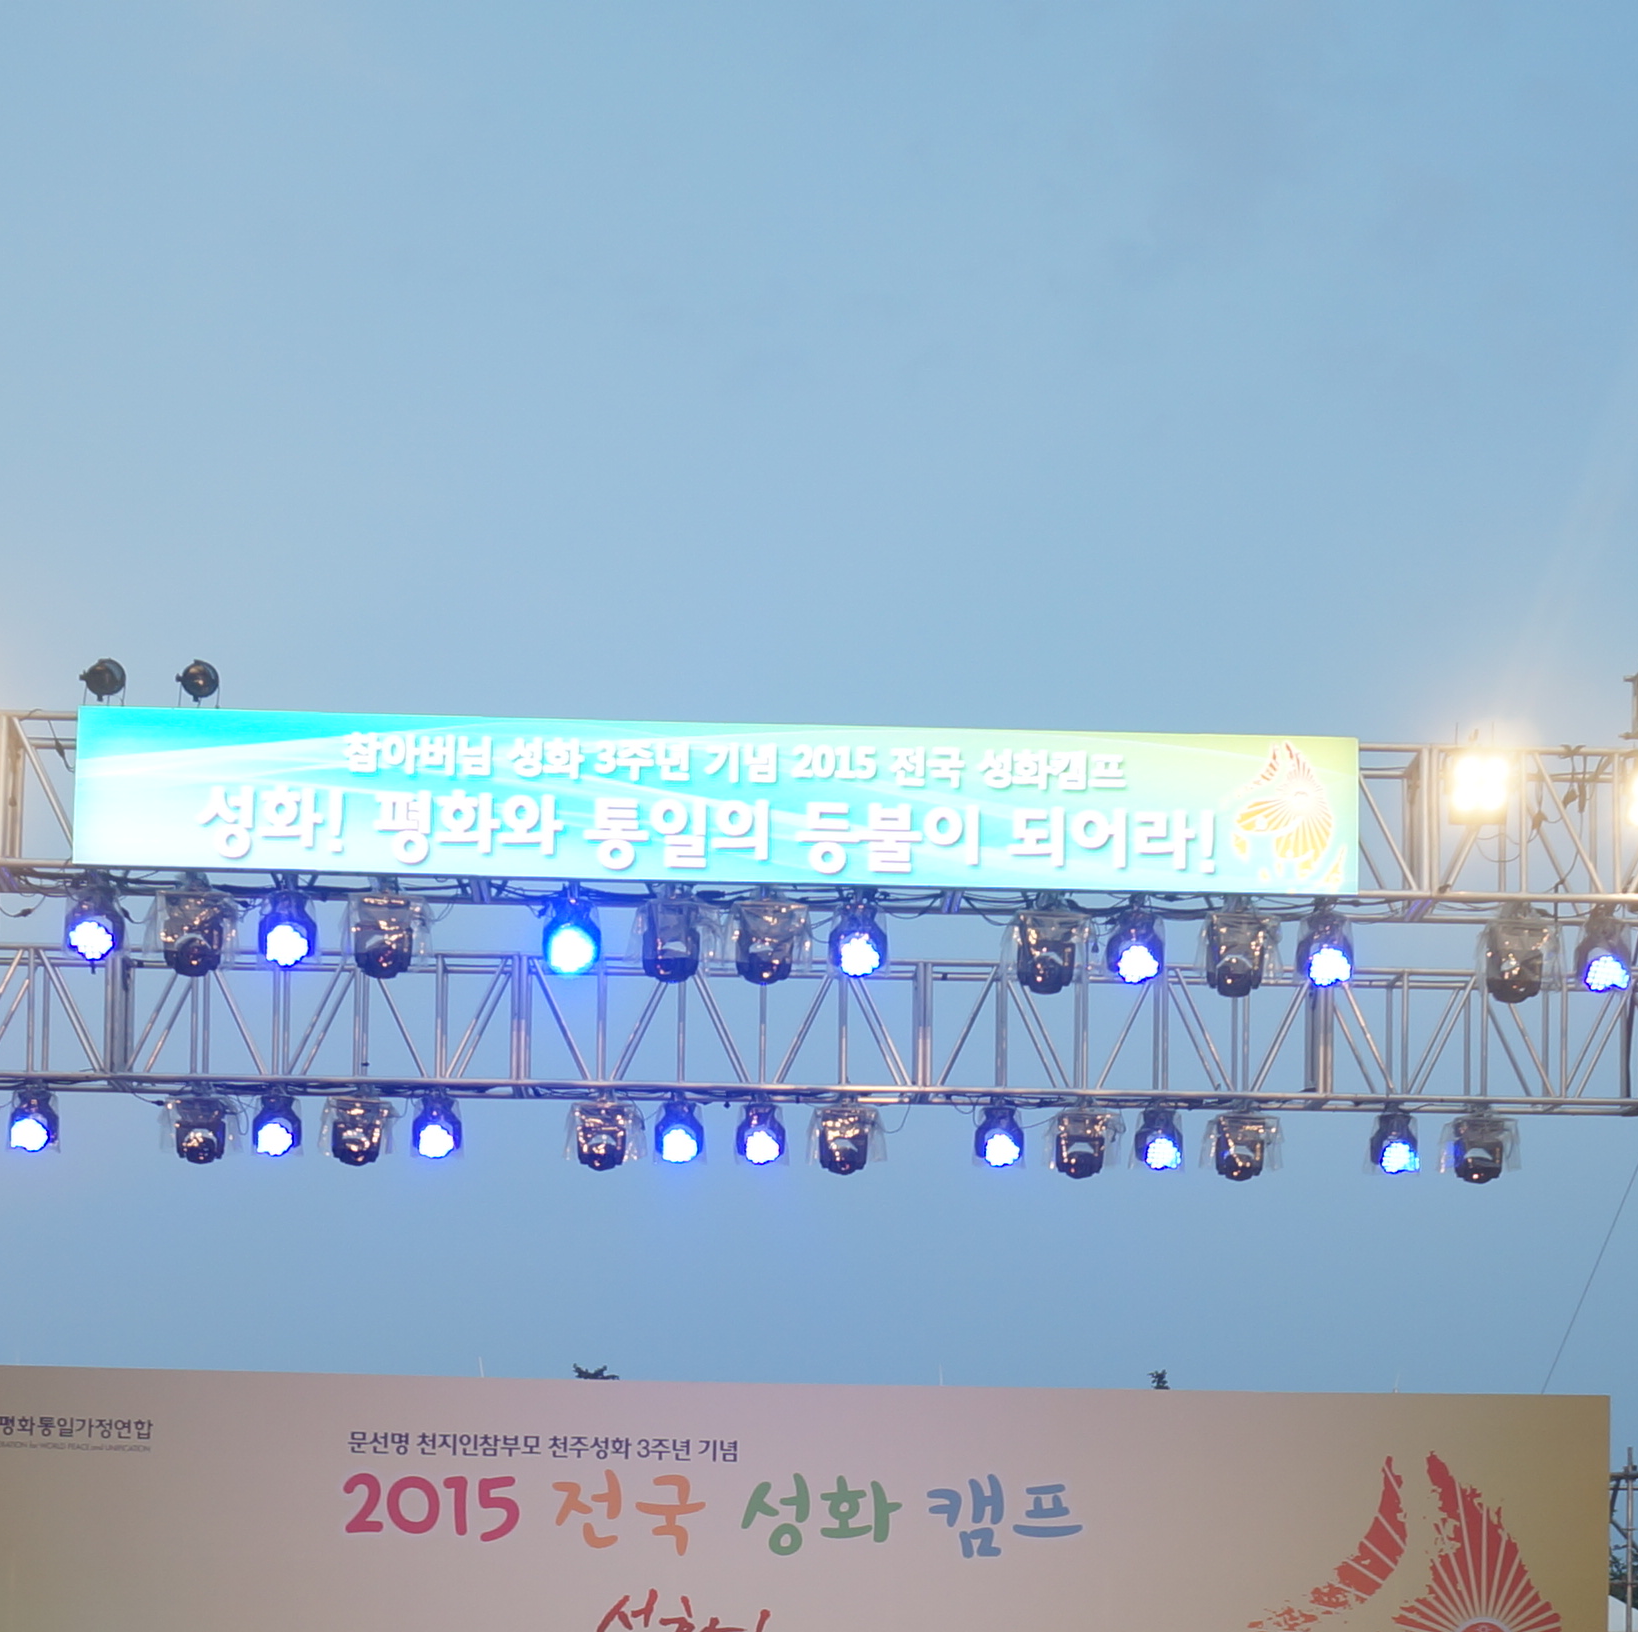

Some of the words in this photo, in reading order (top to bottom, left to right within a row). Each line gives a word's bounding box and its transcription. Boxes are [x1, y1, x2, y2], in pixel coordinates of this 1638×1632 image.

[343, 732, 492, 777] 참아버님
[509, 737, 586, 781] 성화
[594, 740, 692, 783] 3주년
[704, 743, 778, 784] 기념
[791, 745, 877, 781] 2015
[889, 748, 965, 788] 전국
[978, 750, 1128, 791] 성화캠프
[196, 785, 346, 860] 성화!
[374, 790, 564, 865] 평화와
[584, 796, 770, 872] 통일의
[794, 802, 981, 875] 등불이
[1007, 807, 1218, 874] 되어라!
[347, 1431, 410, 1456] 문선명
[416, 1432, 542, 1458] 천지인참부모
[548, 1435, 632, 1460] 천주성화
[636, 1437, 692, 1462] 3주년
[697, 1439, 739, 1463] 기념
[343, 1472, 521, 1542] 2015
[552, 1469, 707, 1557] 전국
[741, 1473, 903, 1557] 성화
[926, 1473, 1085, 1559] 캠프
